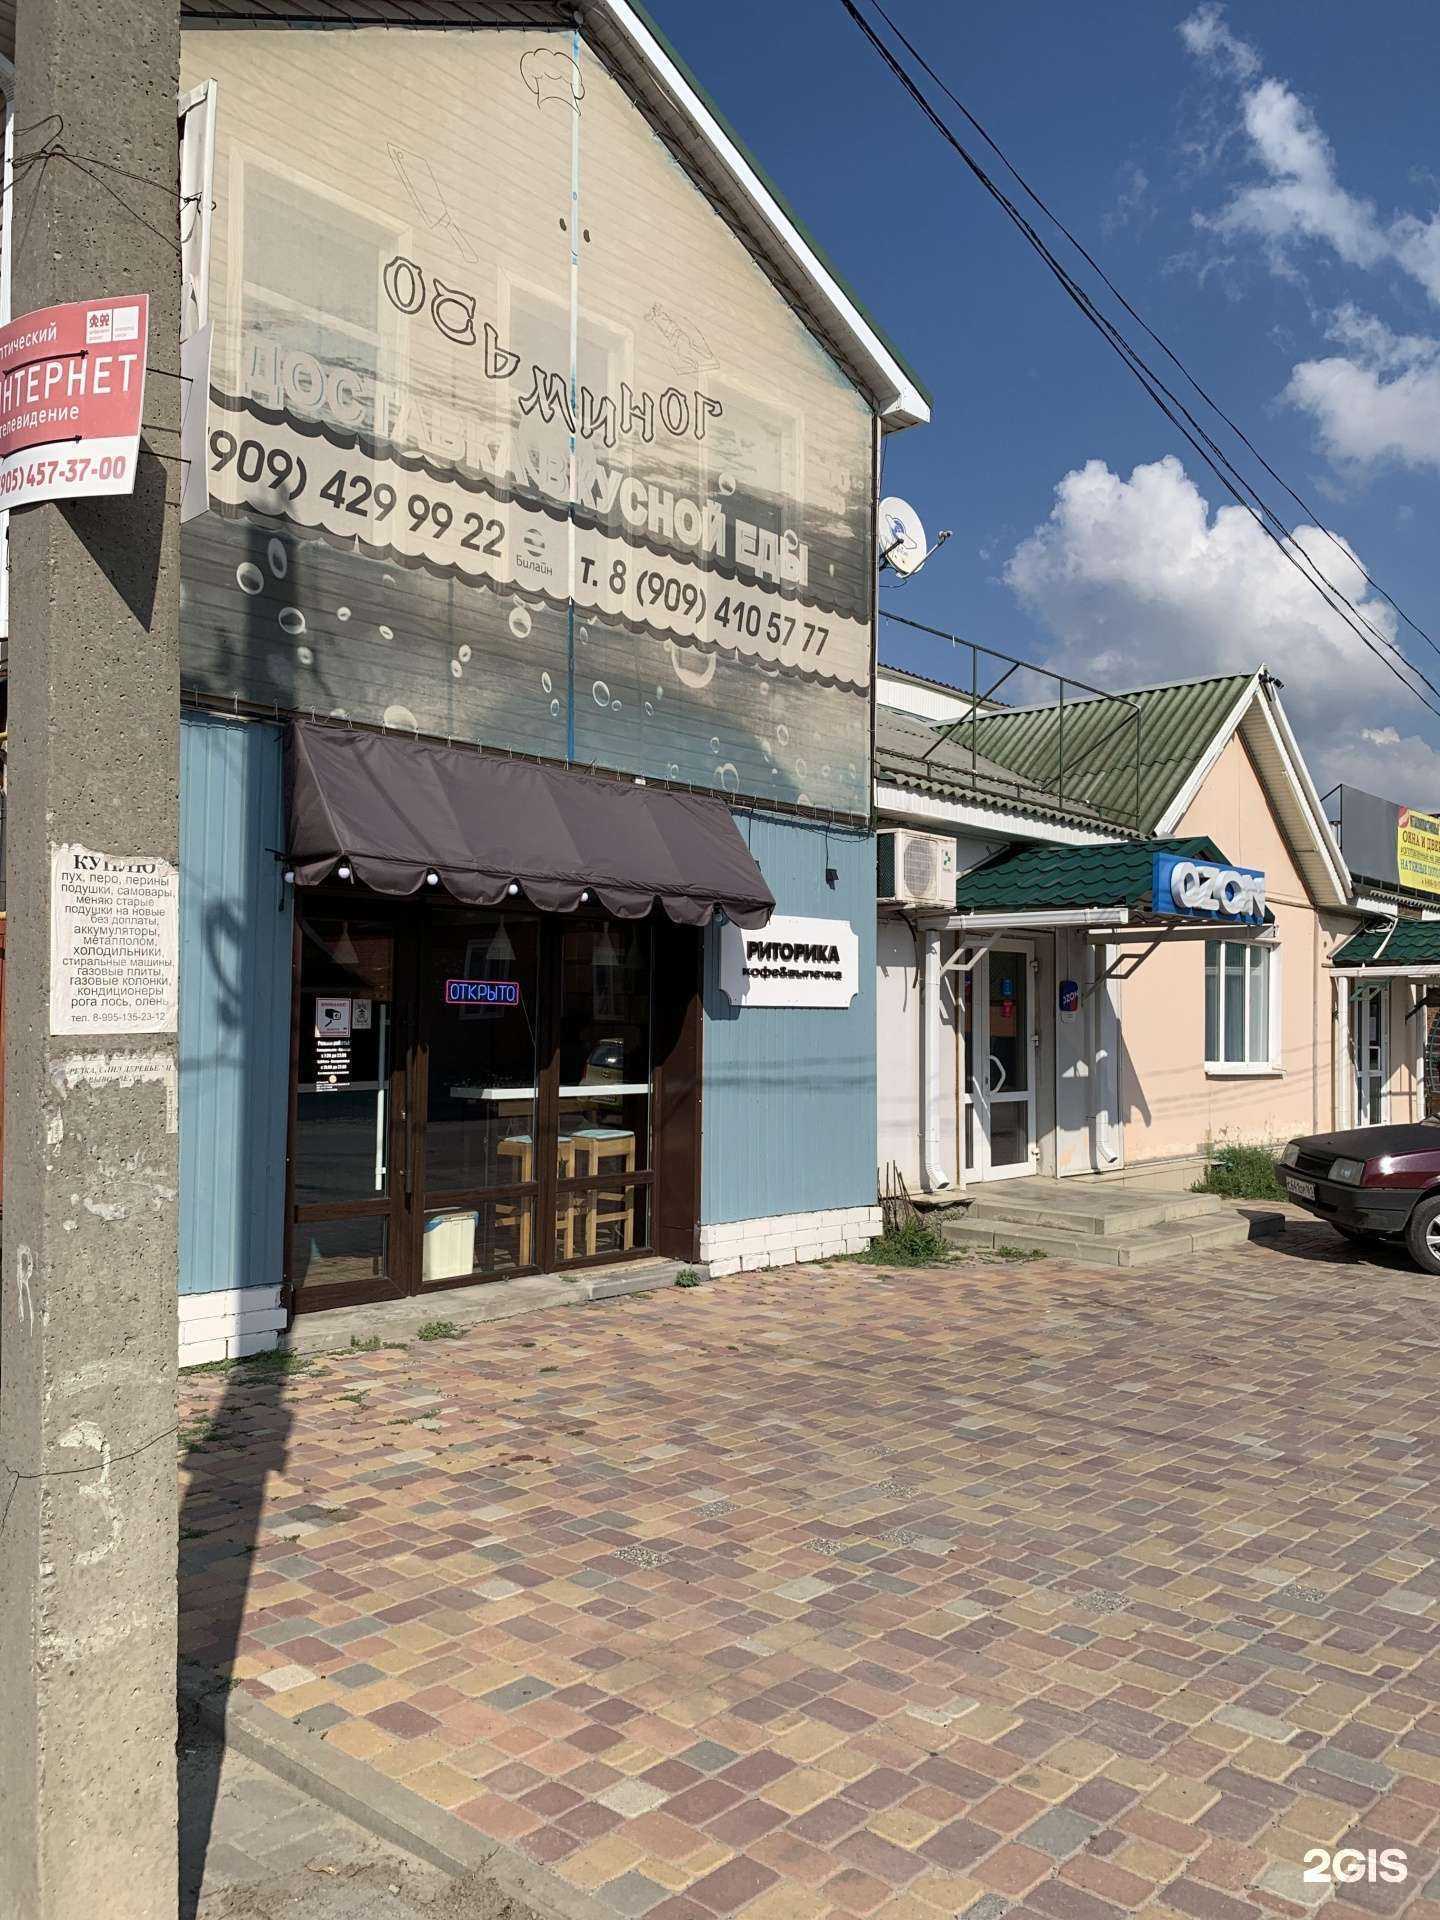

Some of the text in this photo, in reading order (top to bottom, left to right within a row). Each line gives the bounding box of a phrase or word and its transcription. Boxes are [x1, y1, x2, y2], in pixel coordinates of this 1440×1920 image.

[0, 354, 138, 415] НТЕРНЕТ
[208, 427, 505, 558] 909) 429 99 22
[735, 518, 809, 587] ЕДЫ
[516, 554, 554, 577] Билайн
[609, 559, 627, 594] 8
[636, 570, 706, 624] (909)
[714, 596, 761, 637] 410
[767, 612, 796, 646] 57
[802, 622, 829, 656] 77
[1171, 862, 1265, 917] OZON
[65, 905, 113, 916] подушки
[76, 896, 113, 905] меняю
[746, 941, 840, 963] РИТОРИКА
[62, 958, 127, 967] стиральные
[77, 968, 123, 976] газовые
[69, 977, 119, 985] газовые
[450, 983, 515, 1002] ОТКРЫТО
[71, 998, 97, 1009] рога
